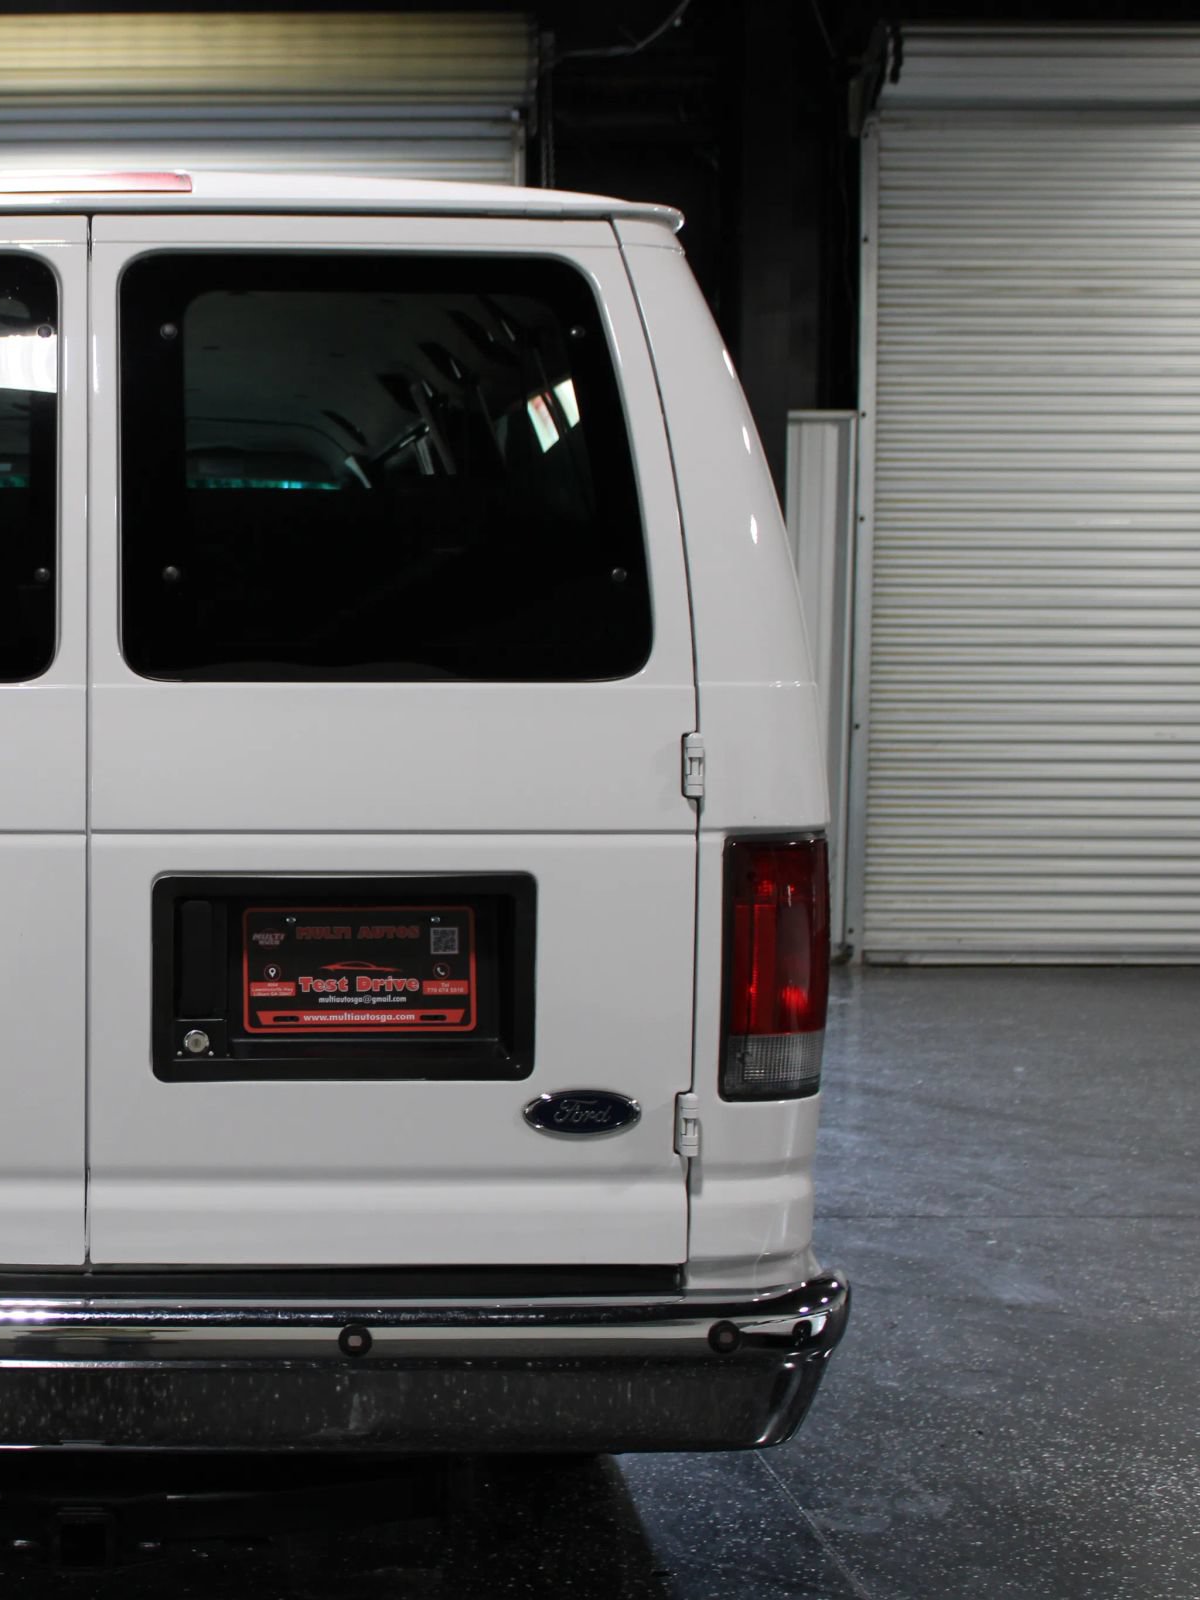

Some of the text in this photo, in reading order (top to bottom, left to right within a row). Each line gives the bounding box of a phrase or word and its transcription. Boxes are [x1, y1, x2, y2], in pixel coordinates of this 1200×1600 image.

[358, 926, 420, 939] AUTOS
[298, 975, 420, 993] Test Drive
[303, 1012, 416, 1023] www.multiautosga.com
[553, 1099, 613, 1124] Ford
